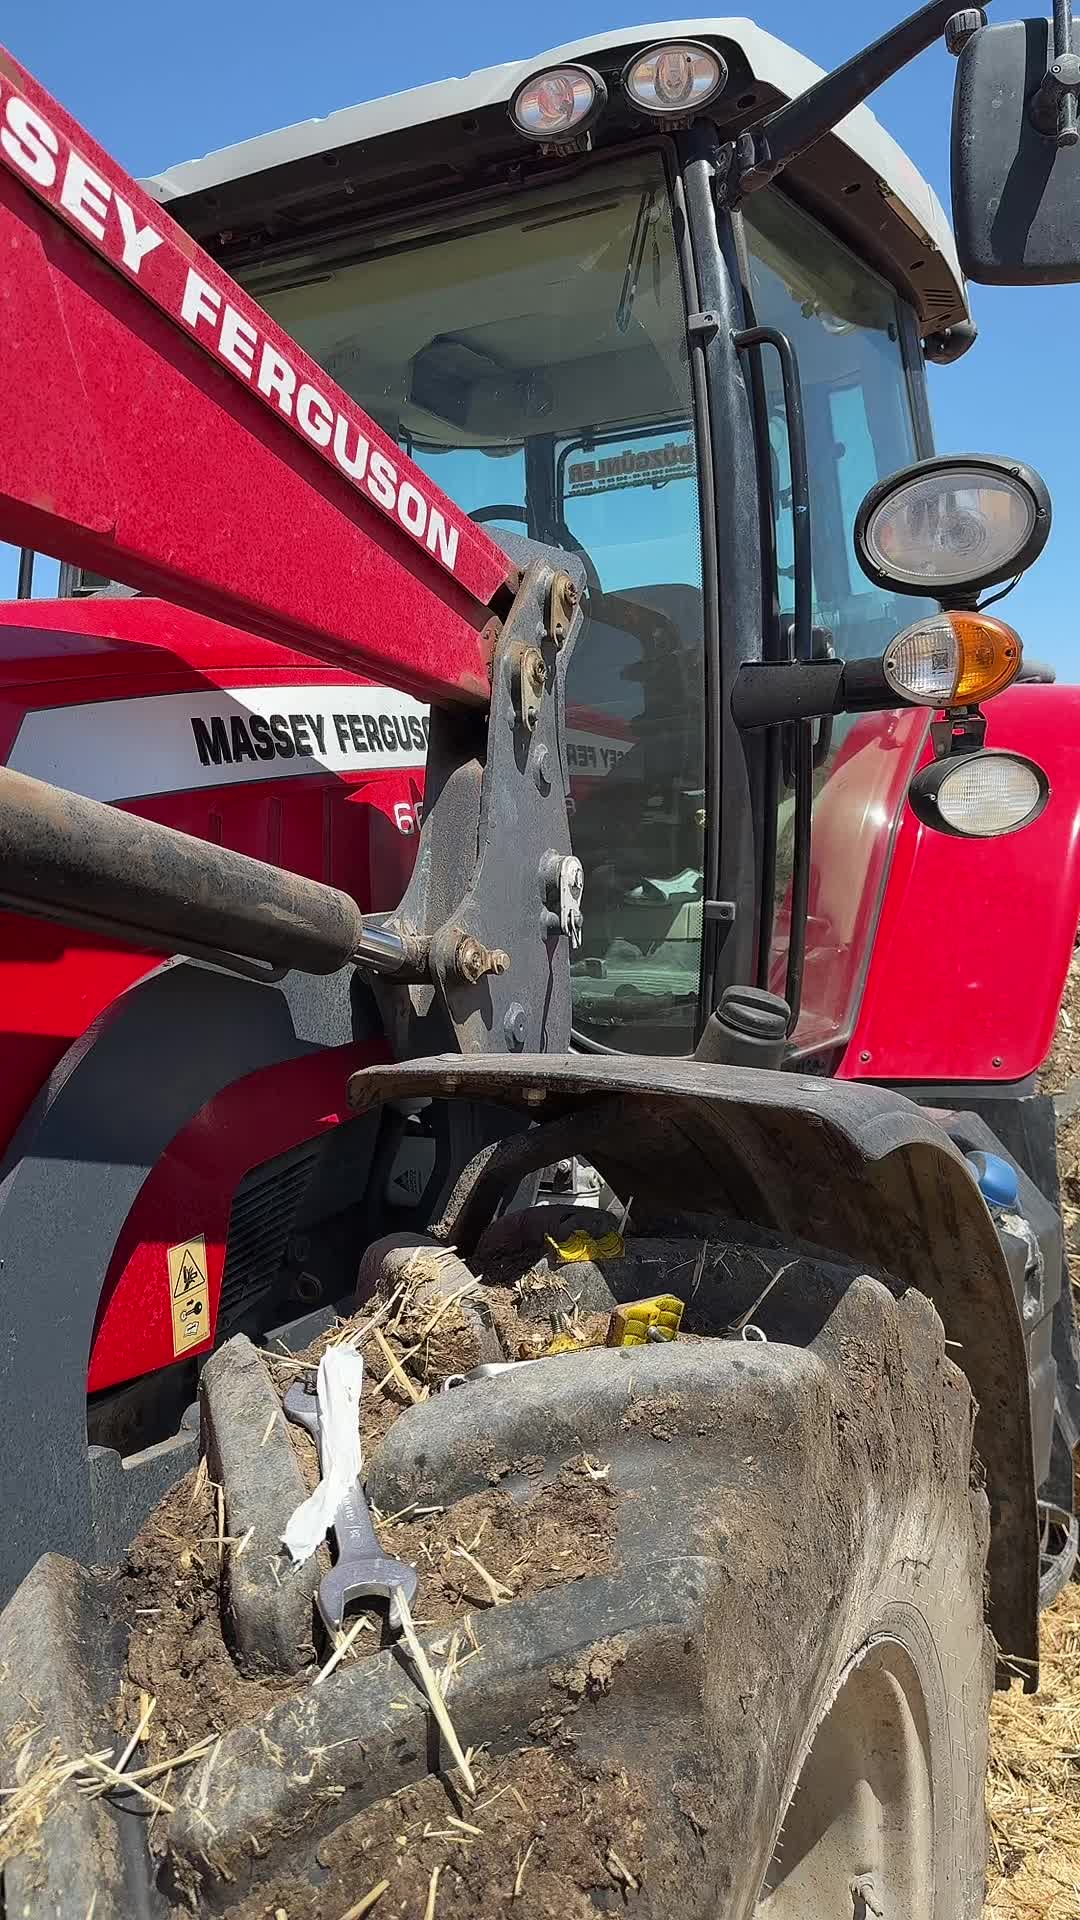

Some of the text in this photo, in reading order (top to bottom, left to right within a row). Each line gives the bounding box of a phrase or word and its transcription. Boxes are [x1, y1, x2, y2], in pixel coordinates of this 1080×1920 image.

[0, 96, 459, 570] SEY FERGUSON
[191, 714, 327, 766] MASSEY
